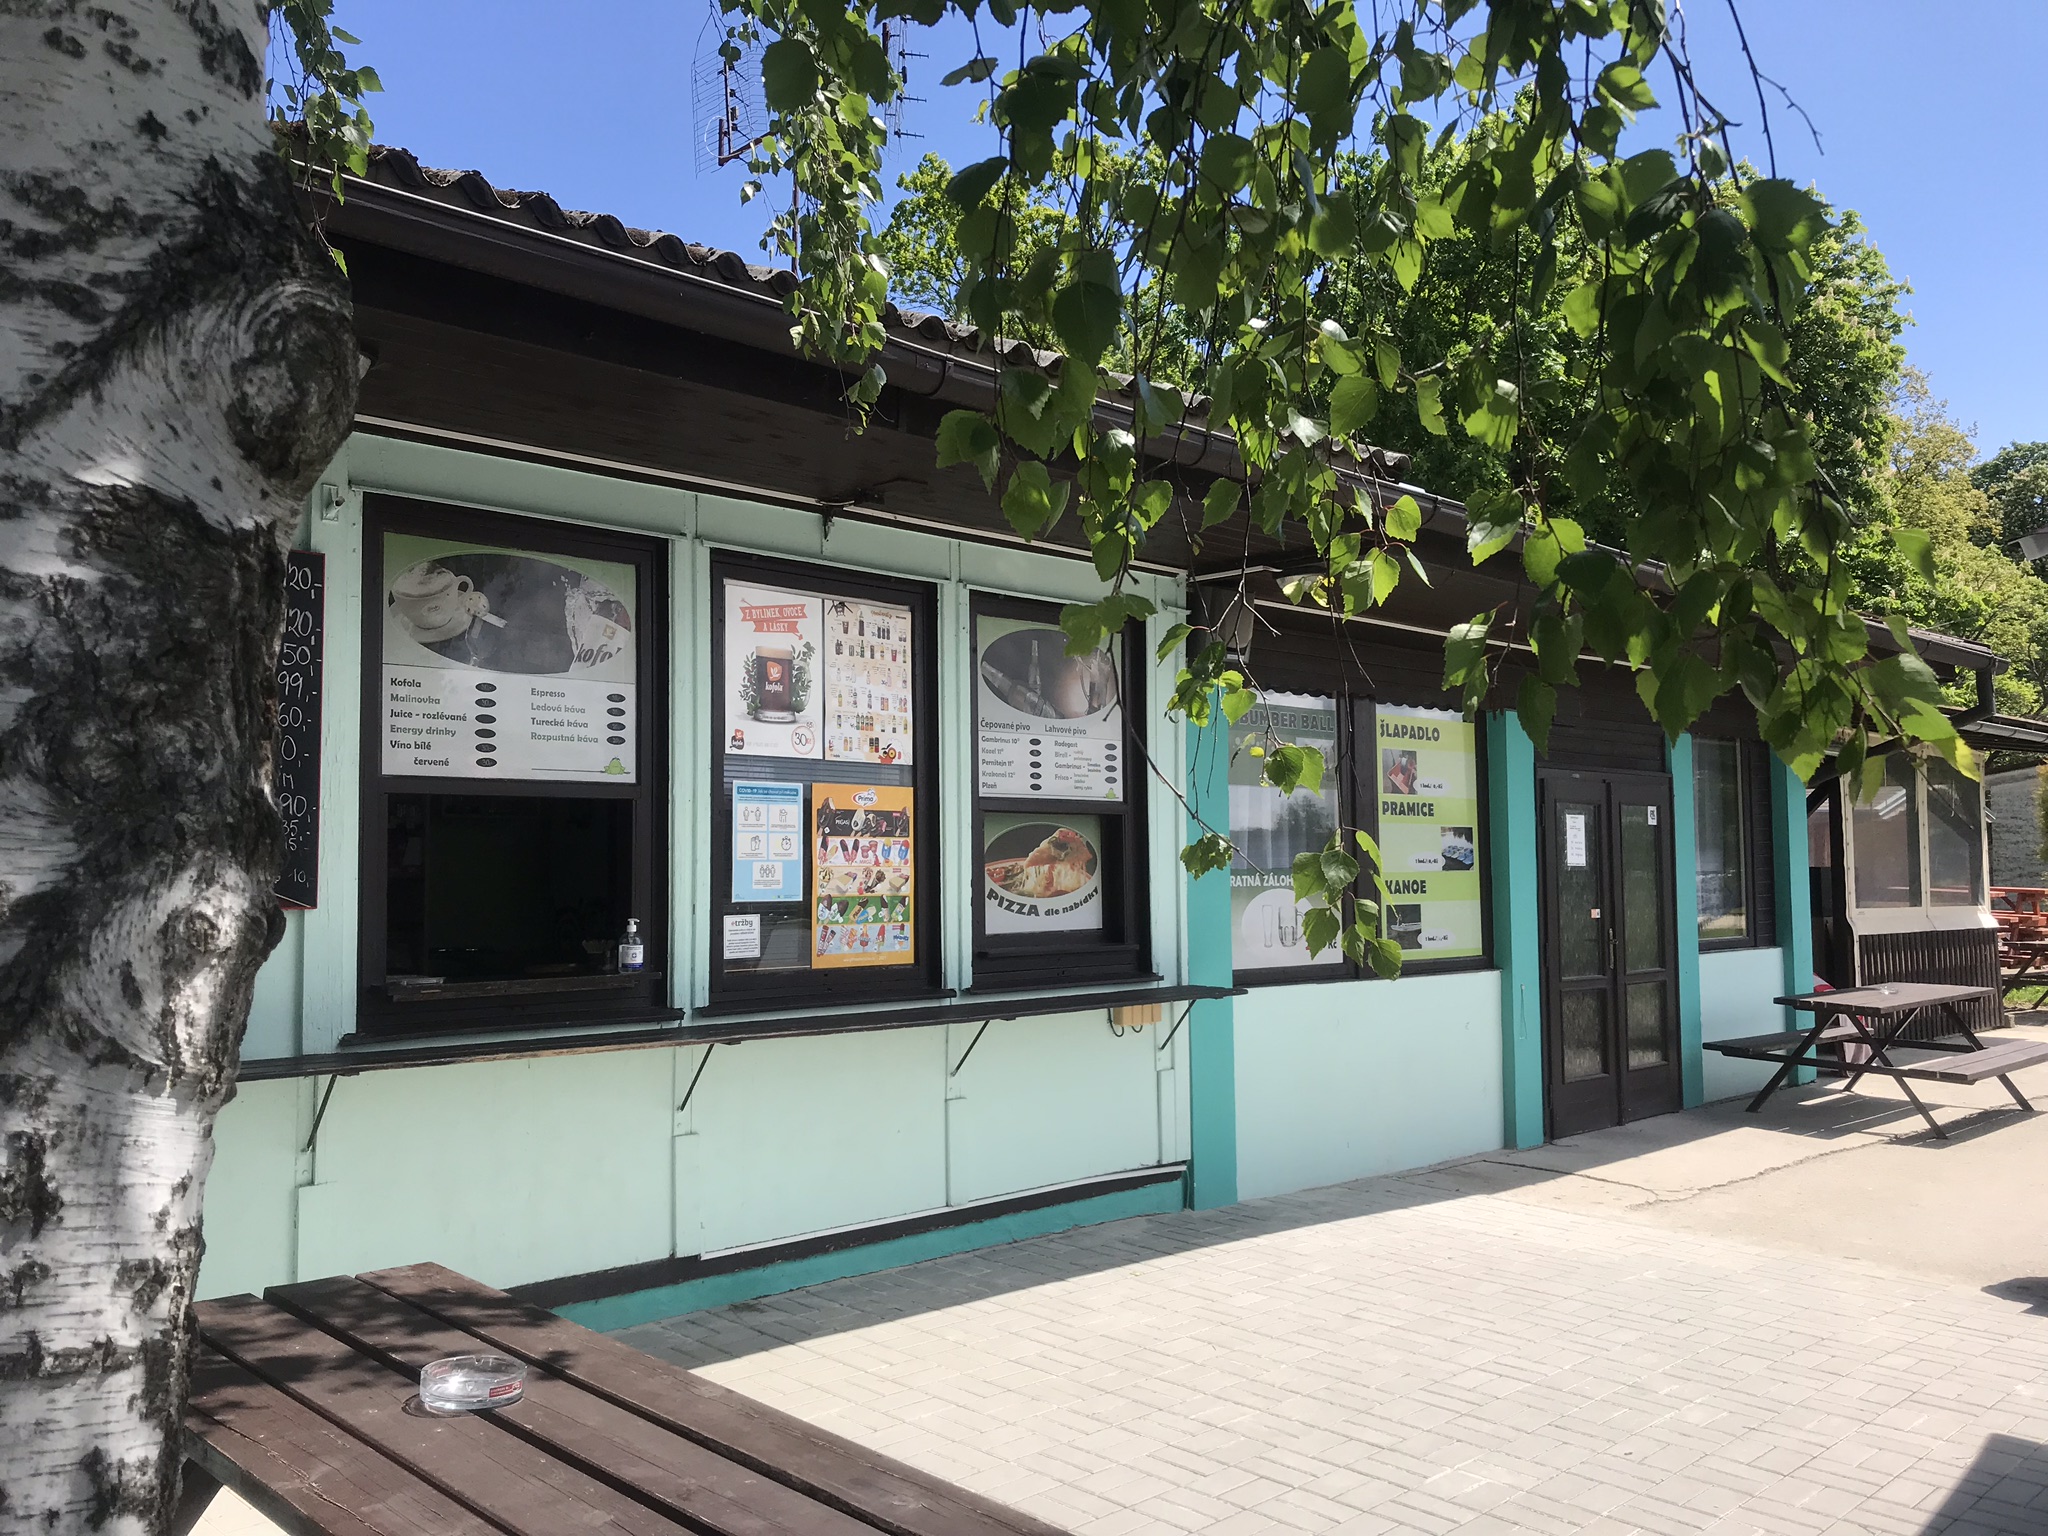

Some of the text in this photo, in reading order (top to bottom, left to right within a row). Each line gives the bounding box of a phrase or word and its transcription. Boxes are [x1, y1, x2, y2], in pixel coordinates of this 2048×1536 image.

[390, 678, 421, 688] Kofola
[390, 693, 441, 705] Malinovka
[531, 688, 566, 698] Espresso
[531, 702, 586, 714] Ledová káva
[390, 708, 413, 718] Juice
[422, 711, 467, 721] rozlévané
[1239, 708, 1334, 732] BUMBER BALL
[531, 717, 588, 729] Turecká káva
[980, 717, 1031, 732] Čepované pivo
[390, 724, 456, 737] Energy drinky
[1044, 724, 1087, 736] Lahvové pivo
[1380, 719, 1440, 742] ŠLAPADLO
[531, 732, 575, 742] Rozpustná
[577, 734, 599, 744] káva
[390, 739, 411, 750] Víno
[414, 741, 432, 750] bílé
[413, 756, 450, 766] červené
[1382, 801, 1435, 817] PRAMICE
[1230, 872, 1294, 887] RATNÁ ZÁLOH
[1385, 879, 1427, 895] KANOE
[986, 887, 1040, 917] PIZZA
